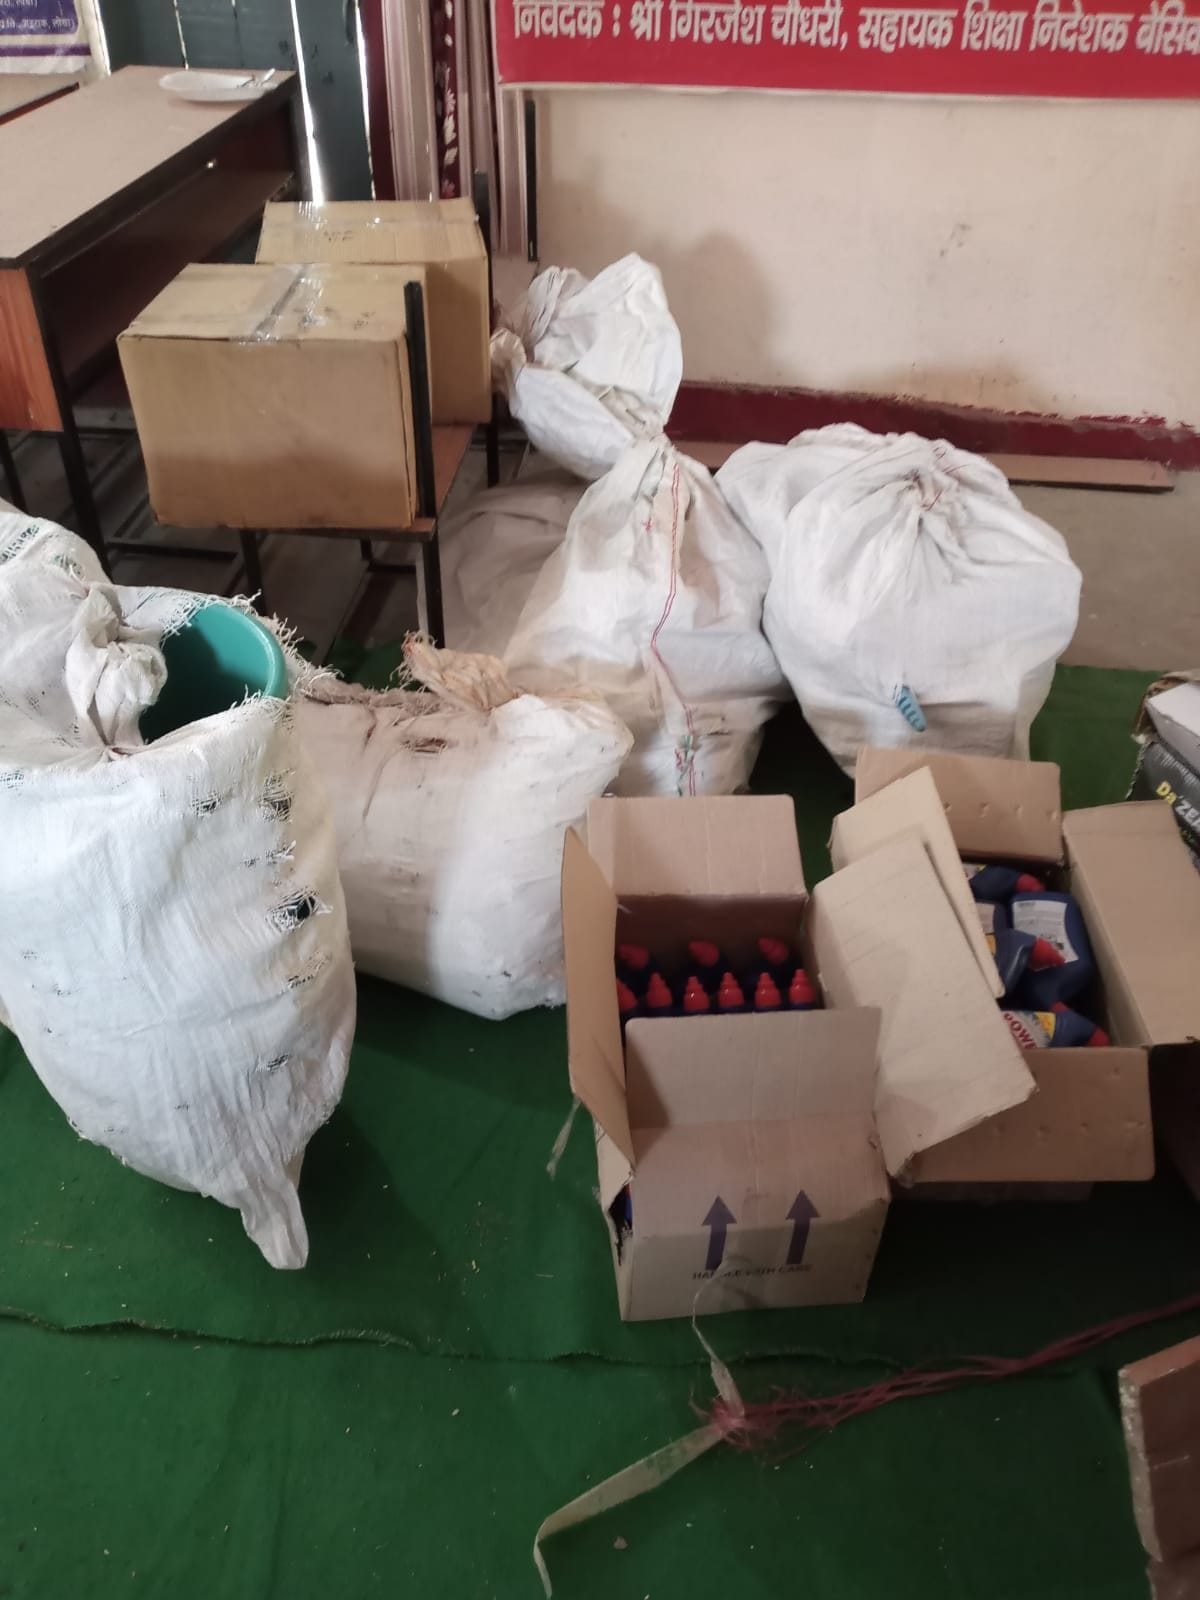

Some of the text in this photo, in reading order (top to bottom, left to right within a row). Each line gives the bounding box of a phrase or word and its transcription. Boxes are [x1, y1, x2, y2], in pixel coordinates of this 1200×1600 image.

[512, 0, 605, 39] निवदक
[612, 4, 622, 38] :
[857, 7, 959, 53] सहायक
[960, 0, 1028, 52] शिक्षा
[1029, 0, 1134, 53] निदेशक
[692, 1269, 742, 1280] HALE
